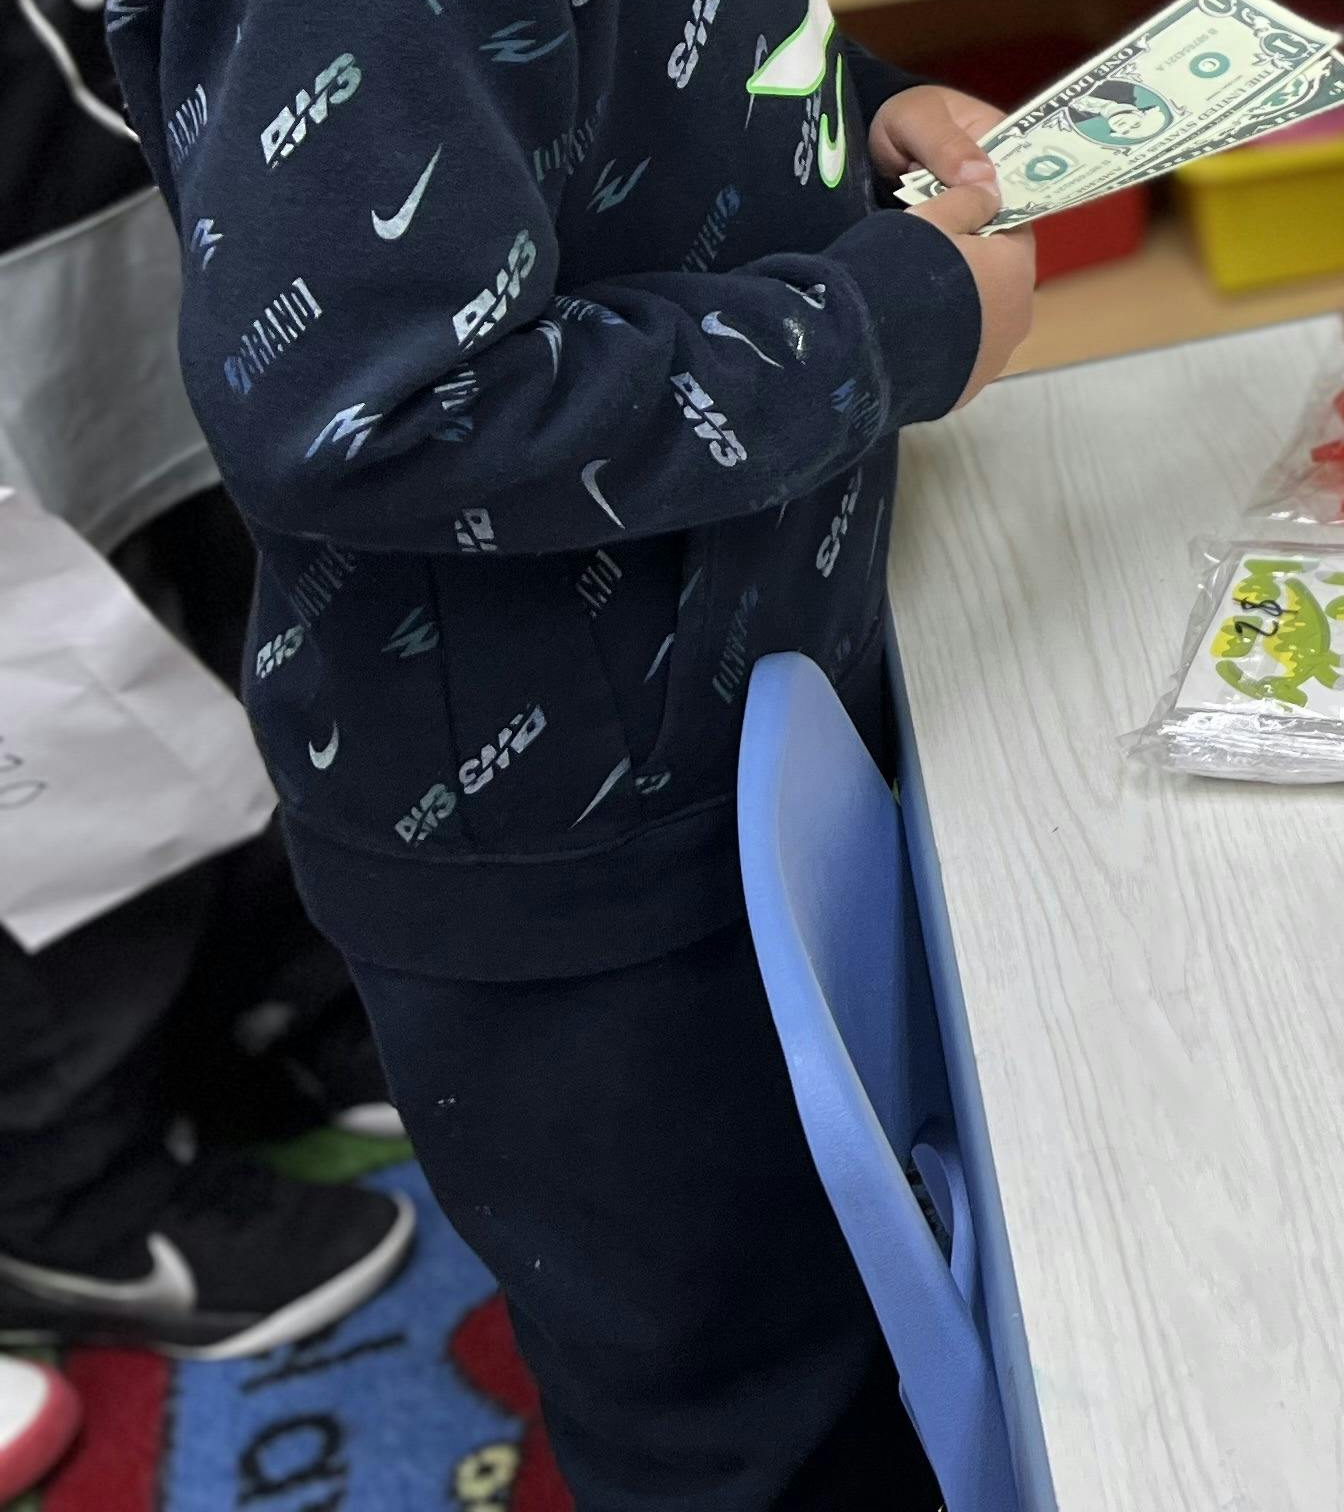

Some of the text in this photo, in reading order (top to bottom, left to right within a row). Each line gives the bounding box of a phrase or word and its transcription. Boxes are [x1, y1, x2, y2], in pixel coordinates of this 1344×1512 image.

[1018, 46, 1135, 129] ONE DOLLAR
[1248, 69, 1275, 89] THE
[1196, 83, 1255, 122] UNITED
[1145, 117, 1198, 155] STATES
